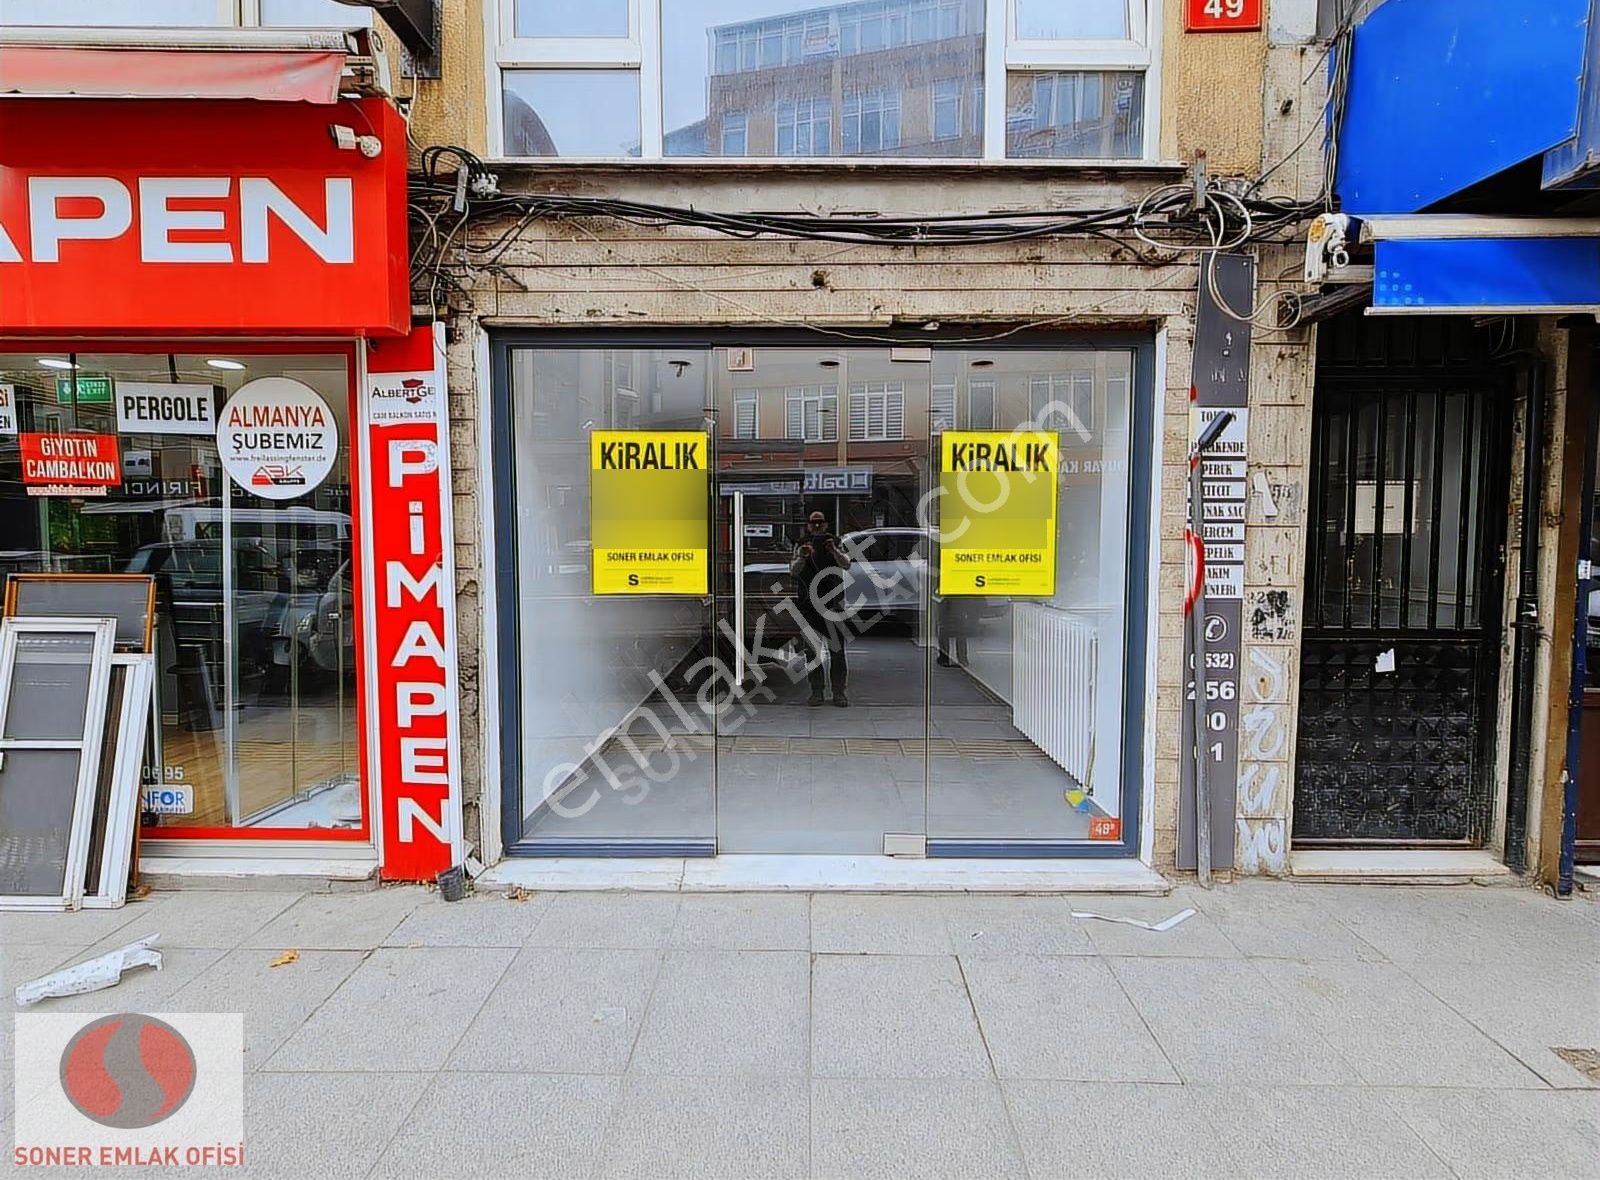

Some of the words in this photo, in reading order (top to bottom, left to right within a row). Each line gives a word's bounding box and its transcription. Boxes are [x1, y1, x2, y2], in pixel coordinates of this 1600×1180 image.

[1203, 0, 1245, 19] 49
[0, 176, 355, 264] PEN
[123, 396, 209, 422] PERGOLE
[228, 405, 326, 428] ALMANYA
[26, 459, 116, 481] CAMBALKON
[607, 552, 636, 562] SONER
[638, 552, 669, 562] EMLAK
[954, 553, 984, 563] SONER
[986, 553, 1017, 563] EMLAK
[1189, 652, 1235, 670] (532)
